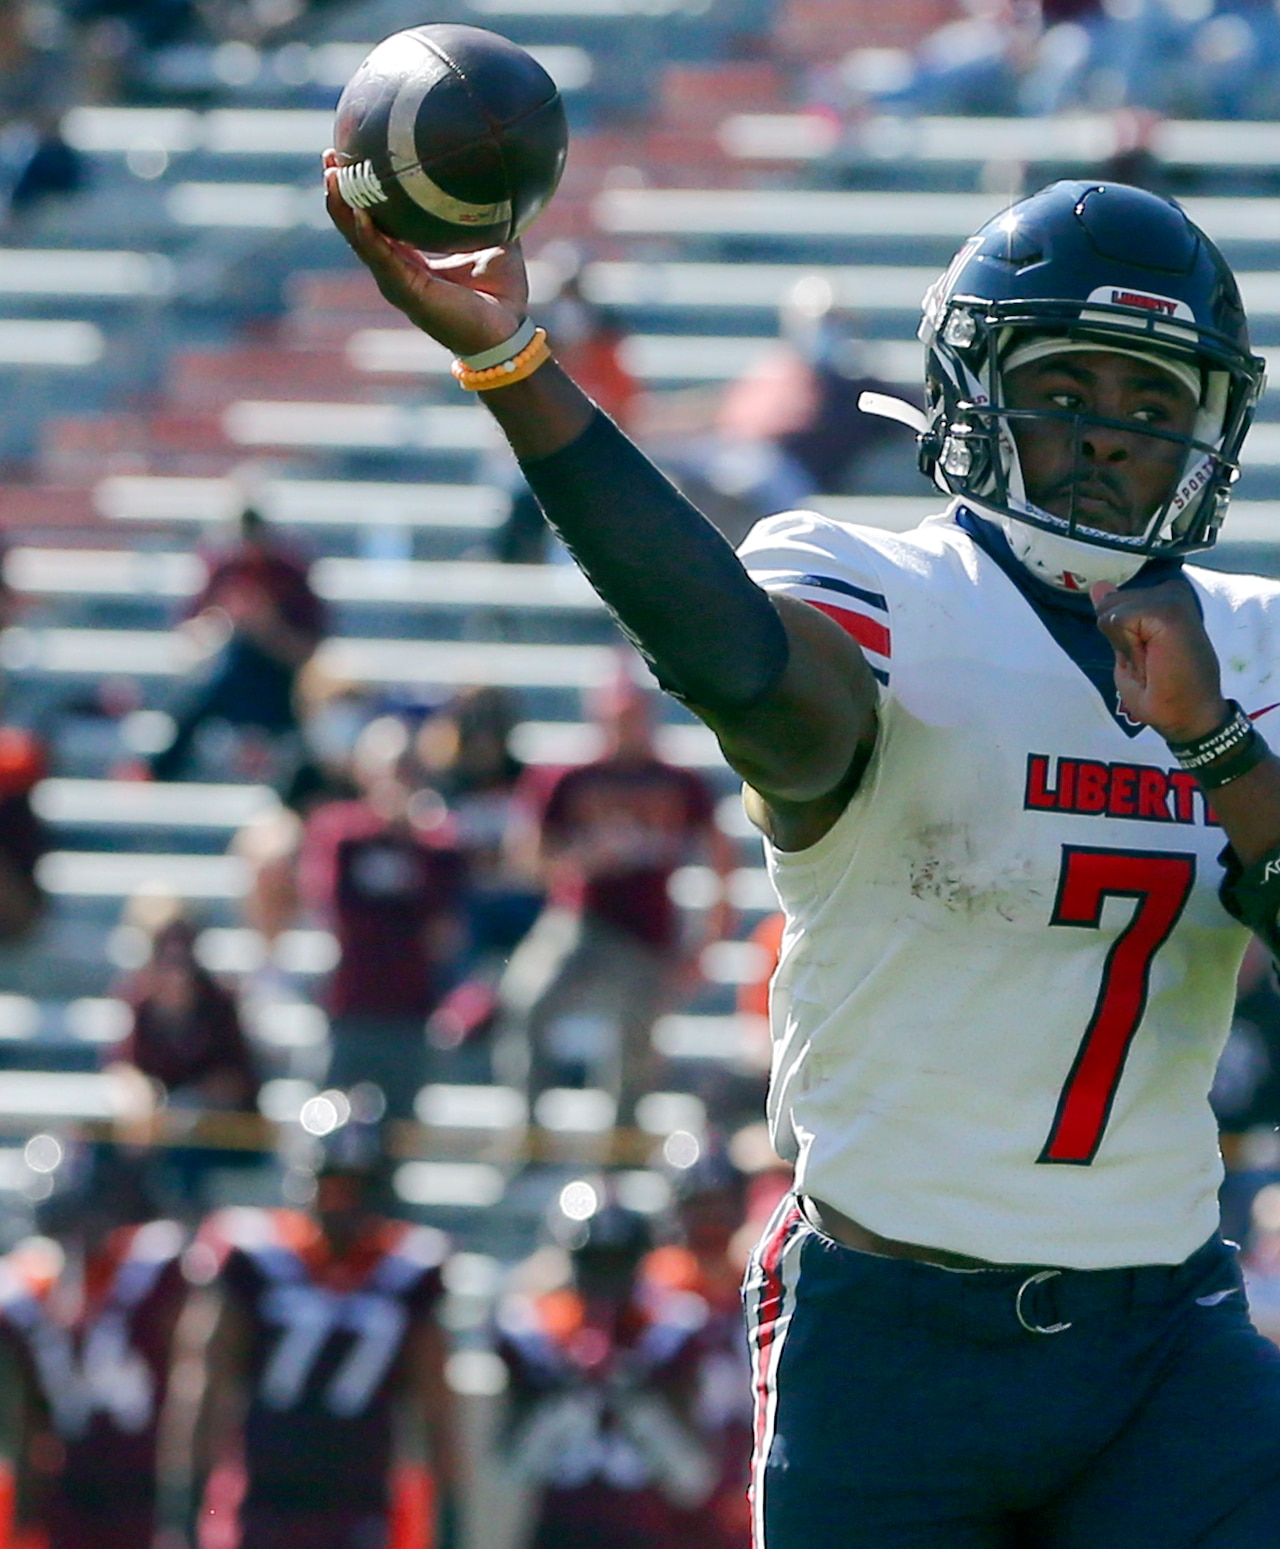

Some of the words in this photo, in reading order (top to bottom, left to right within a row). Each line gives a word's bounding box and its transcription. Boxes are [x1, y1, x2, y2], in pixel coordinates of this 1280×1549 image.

[1111, 290, 1178, 317] LIBERTY
[1198, 721, 1240, 752] everyday
[1035, 844, 1197, 1167] 7
[257, 1282, 407, 1420] 77
